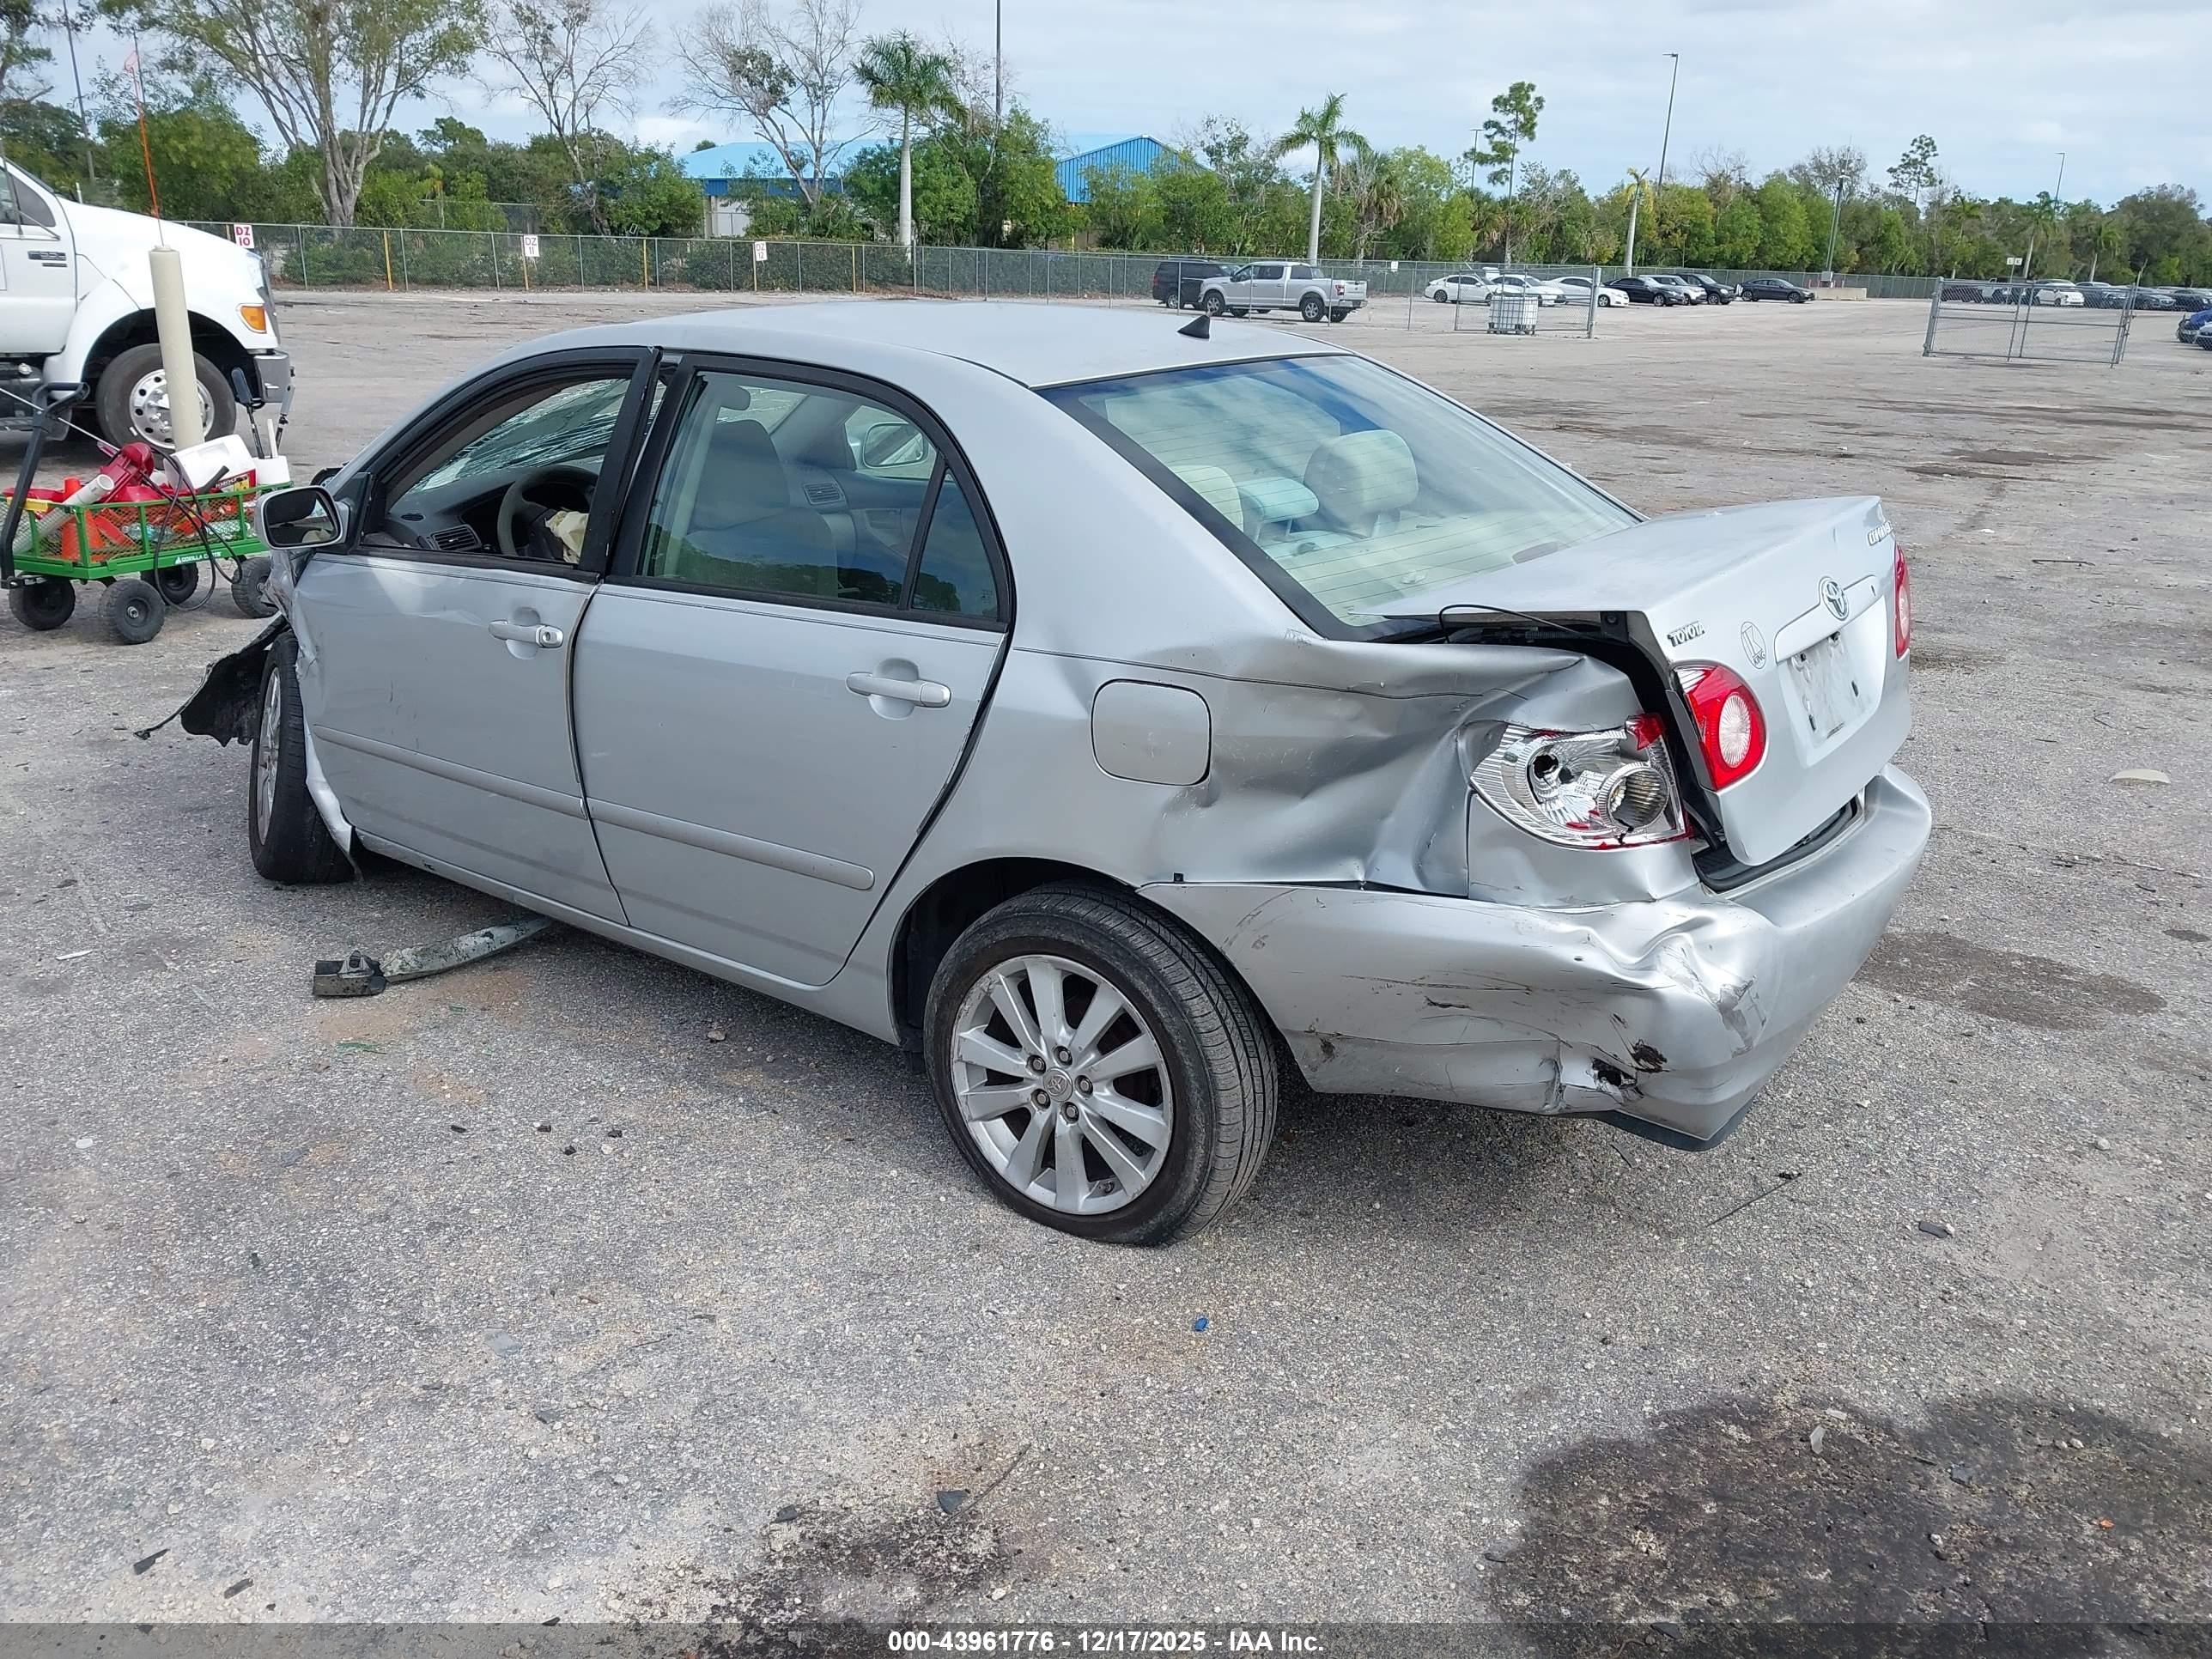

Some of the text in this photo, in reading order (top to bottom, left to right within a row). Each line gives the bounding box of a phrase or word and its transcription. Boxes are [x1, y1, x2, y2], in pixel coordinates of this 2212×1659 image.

[236, 226, 251, 236] DZ
[239, 237, 251, 246] 10
[525, 237, 537, 246] DZ
[529, 246, 535, 255] 11
[757, 242, 766, 251] DZ
[757, 251, 764, 259] 12
[181, 553, 204, 562] GORILLA
[1667, 621, 1705, 647] TOYOTA
[1753, 651, 1765, 665] KING
